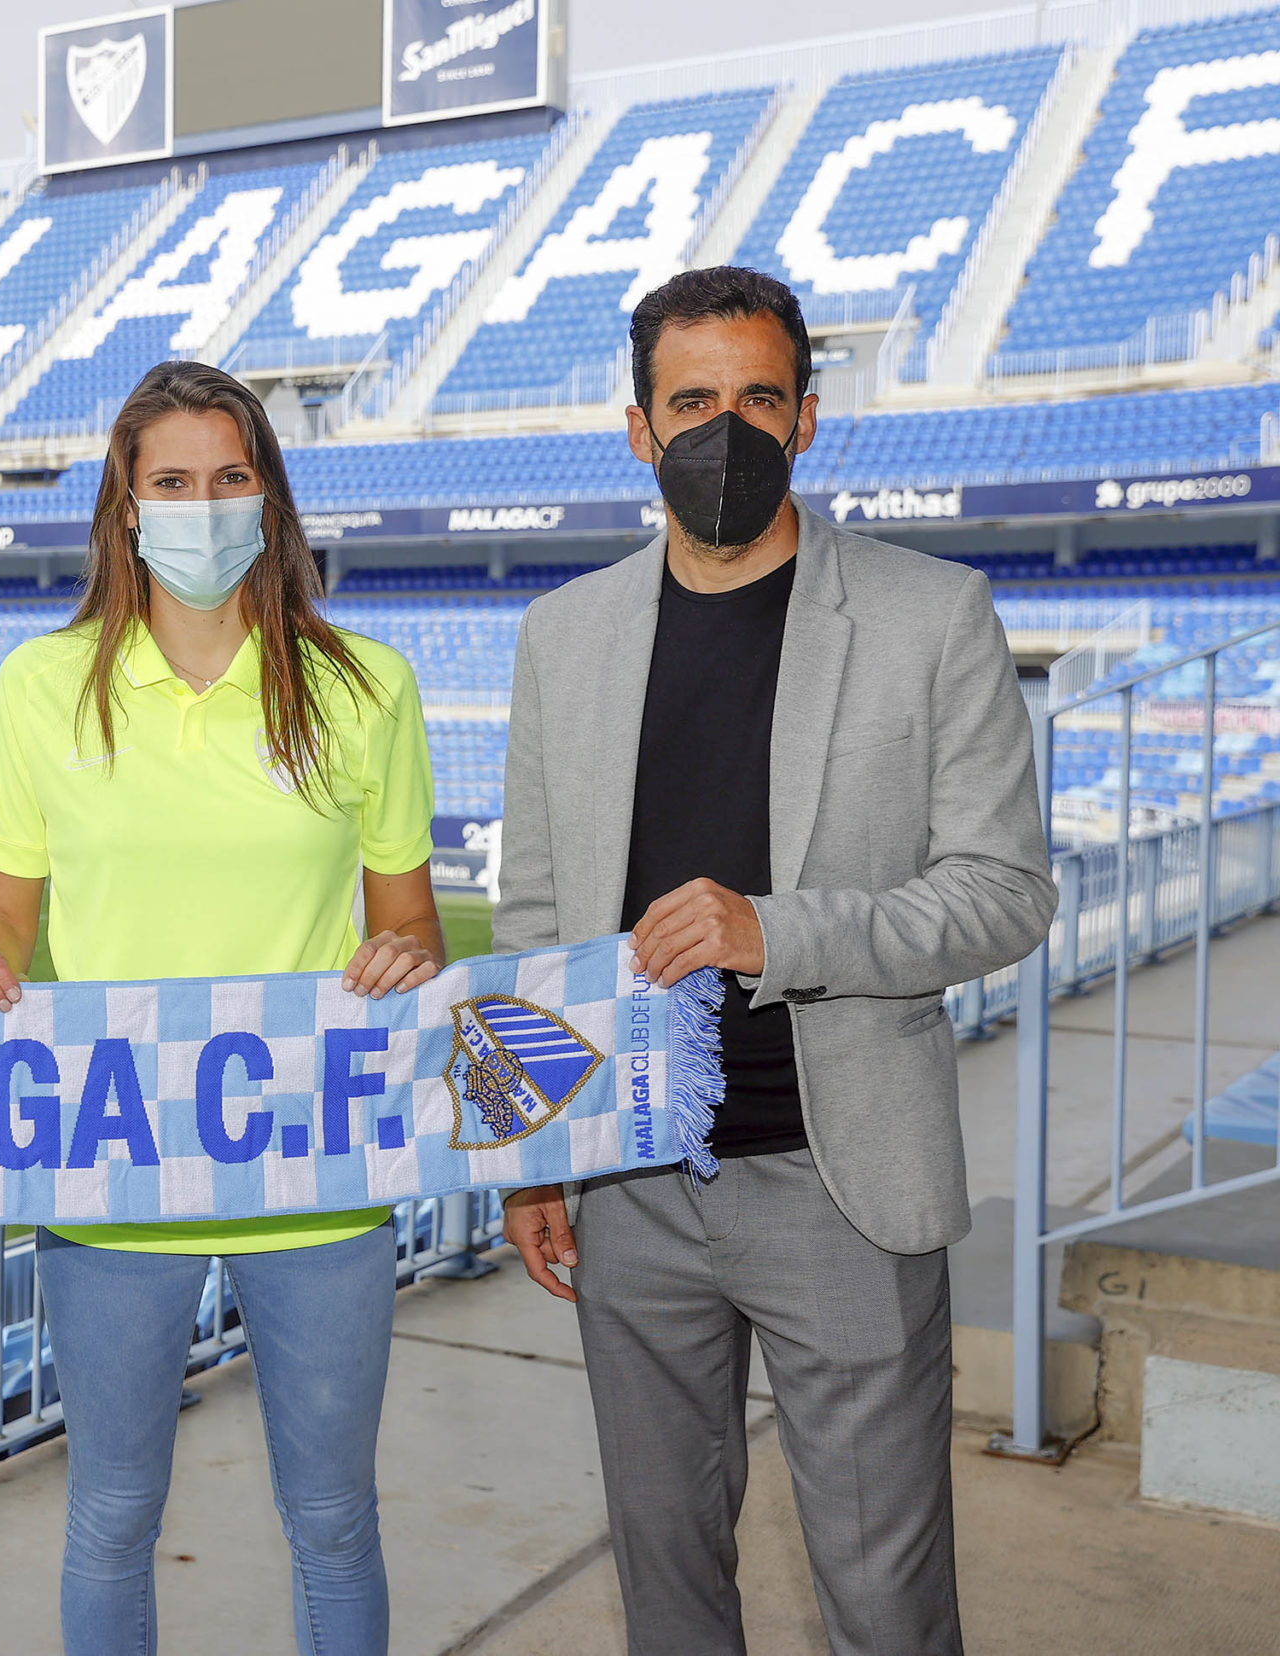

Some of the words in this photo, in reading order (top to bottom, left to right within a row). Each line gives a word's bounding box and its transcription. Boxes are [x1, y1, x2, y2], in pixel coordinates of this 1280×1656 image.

[860, 488, 961, 519] vithas
[1126, 474, 1251, 509] grupo2000
[632, 972, 651, 1001] FUT
[632, 1005, 650, 1024] DE
[631, 1027, 650, 1072] CLUB
[195, 1027, 405, 1164] C.F.
[632, 1074, 656, 1159] MALAGA
